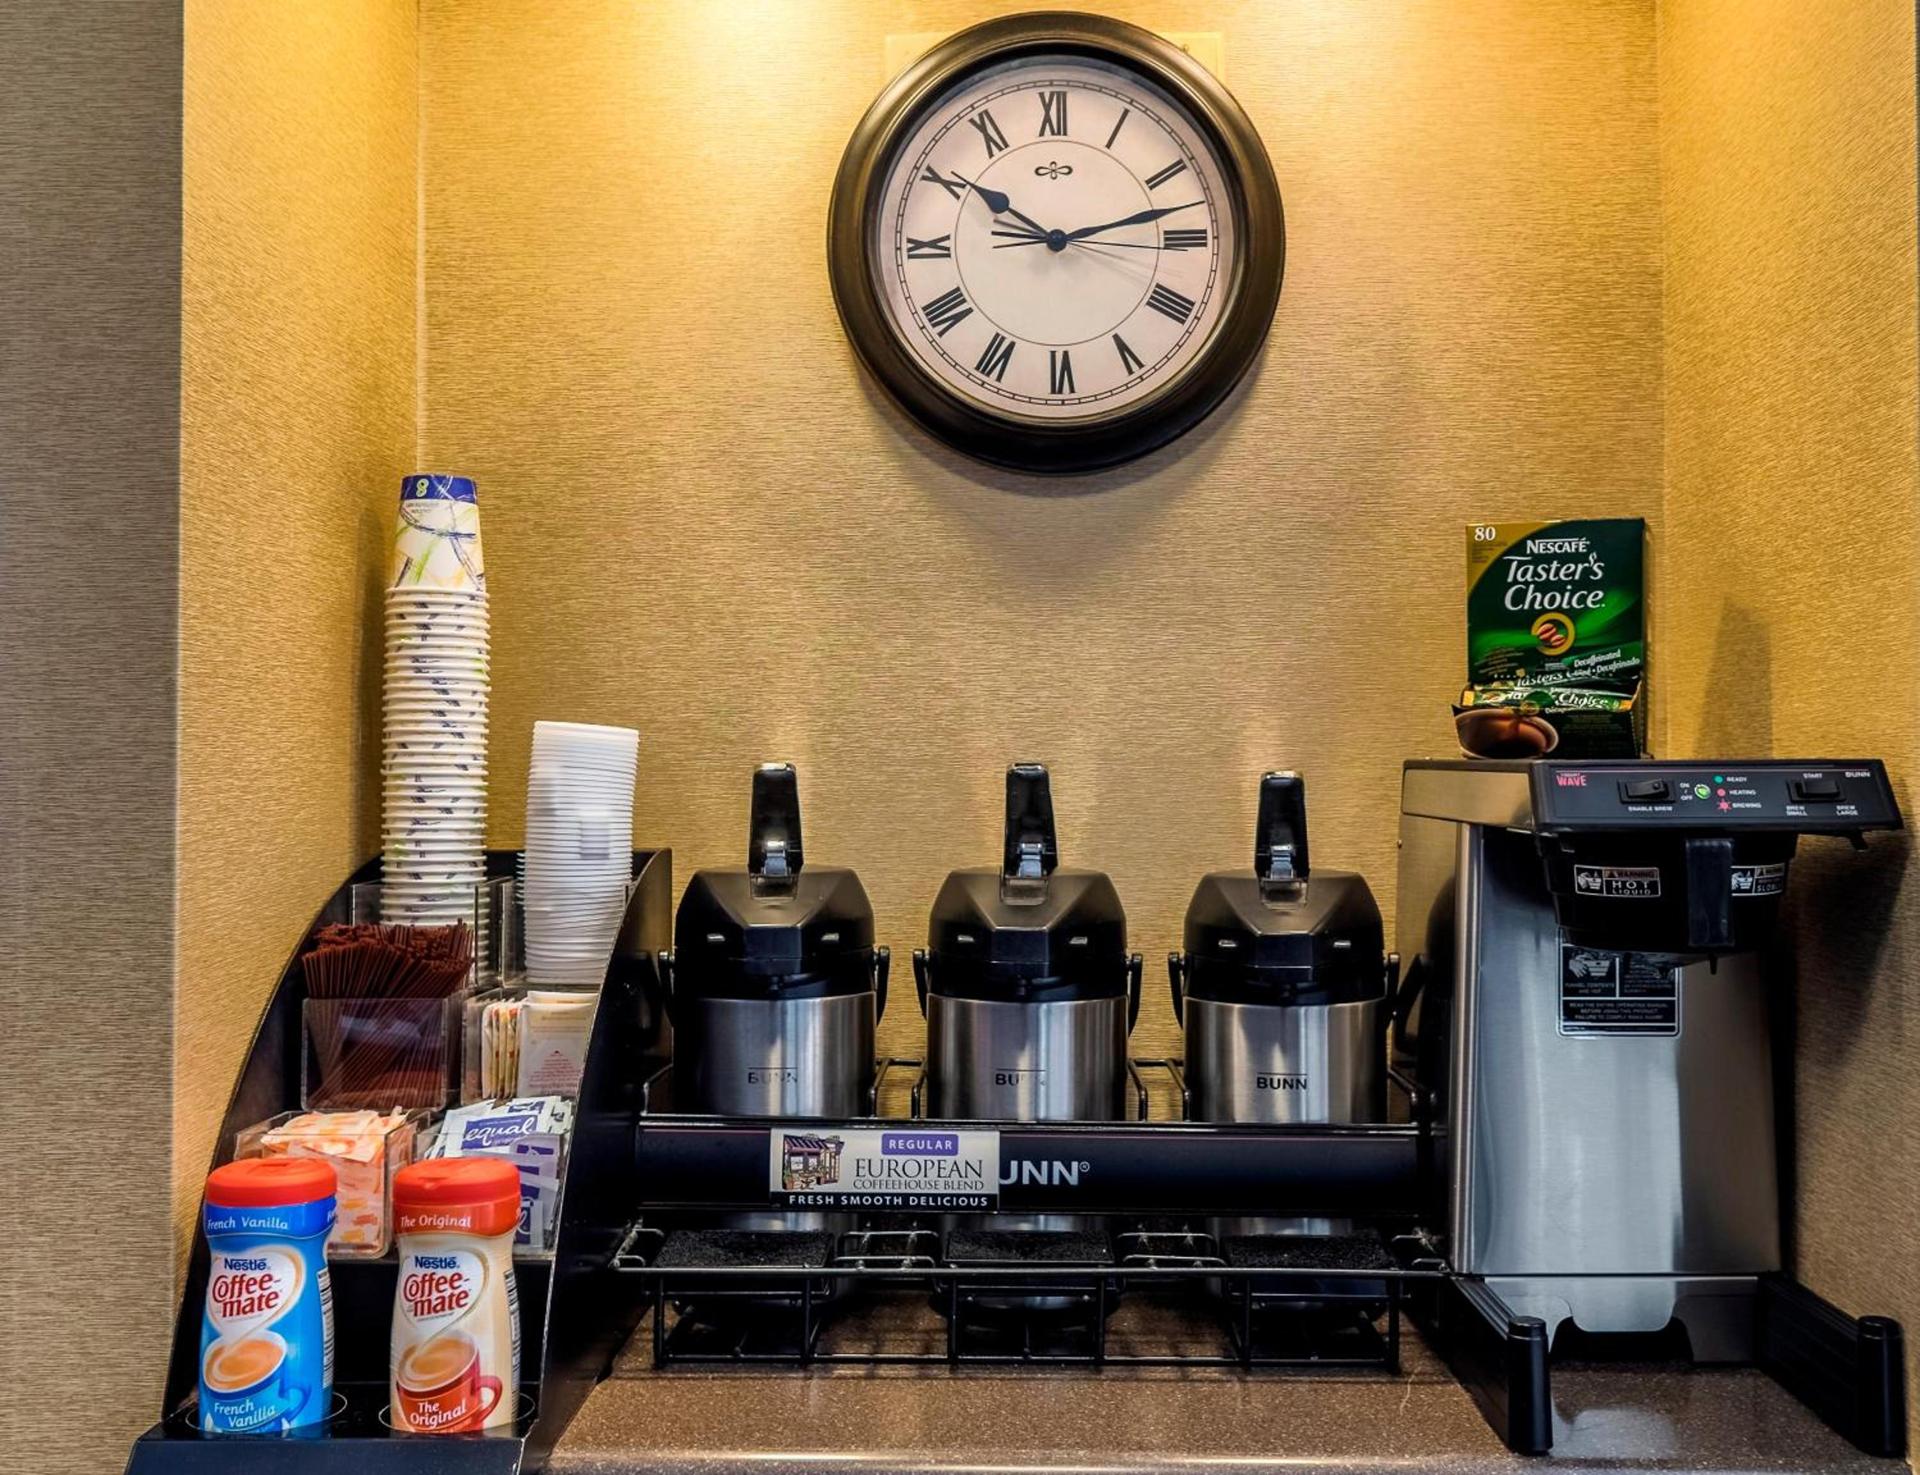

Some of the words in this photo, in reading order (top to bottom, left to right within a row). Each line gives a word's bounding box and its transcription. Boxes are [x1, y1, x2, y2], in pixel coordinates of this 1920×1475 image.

[1038, 90, 1068, 136] XII
[969, 108, 1010, 159] XI
[1048, 350, 1076, 395] VI
[1474, 526, 1497, 542] 80
[1502, 551, 1606, 583] Taster's
[1556, 775, 1587, 787] WAVE
[1612, 880, 1650, 889] HOT
[1256, 1076, 1308, 1090] BUNN
[463, 1116, 535, 1147] equal
[889, 1139, 953, 1151] REGULAR
[855, 1158, 984, 1180] EUROPEAN
[853, 1178, 943, 1192] COFFEEHOUSE
[943, 1178, 985, 1192] BLEND
[788, 1194, 835, 1206] FRESH
[840, 1194, 903, 1207] SMOOTH
[909, 1195, 989, 1208] DELICIOUS
[206, 1215, 236, 1231] French
[240, 1216, 290, 1231] Vanilla
[400, 1215, 416, 1228] The
[418, 1213, 472, 1230] Original
[223, 1257, 268, 1271] Nestlé
[414, 1255, 457, 1270] Nestlé
[222, 1290, 279, 1319] mate
[413, 1289, 469, 1318] mate
[213, 1398, 255, 1416] French
[409, 1396, 467, 1430] Original
[417, 1400, 441, 1414] The
[228, 1404, 277, 1428] Vanilla
